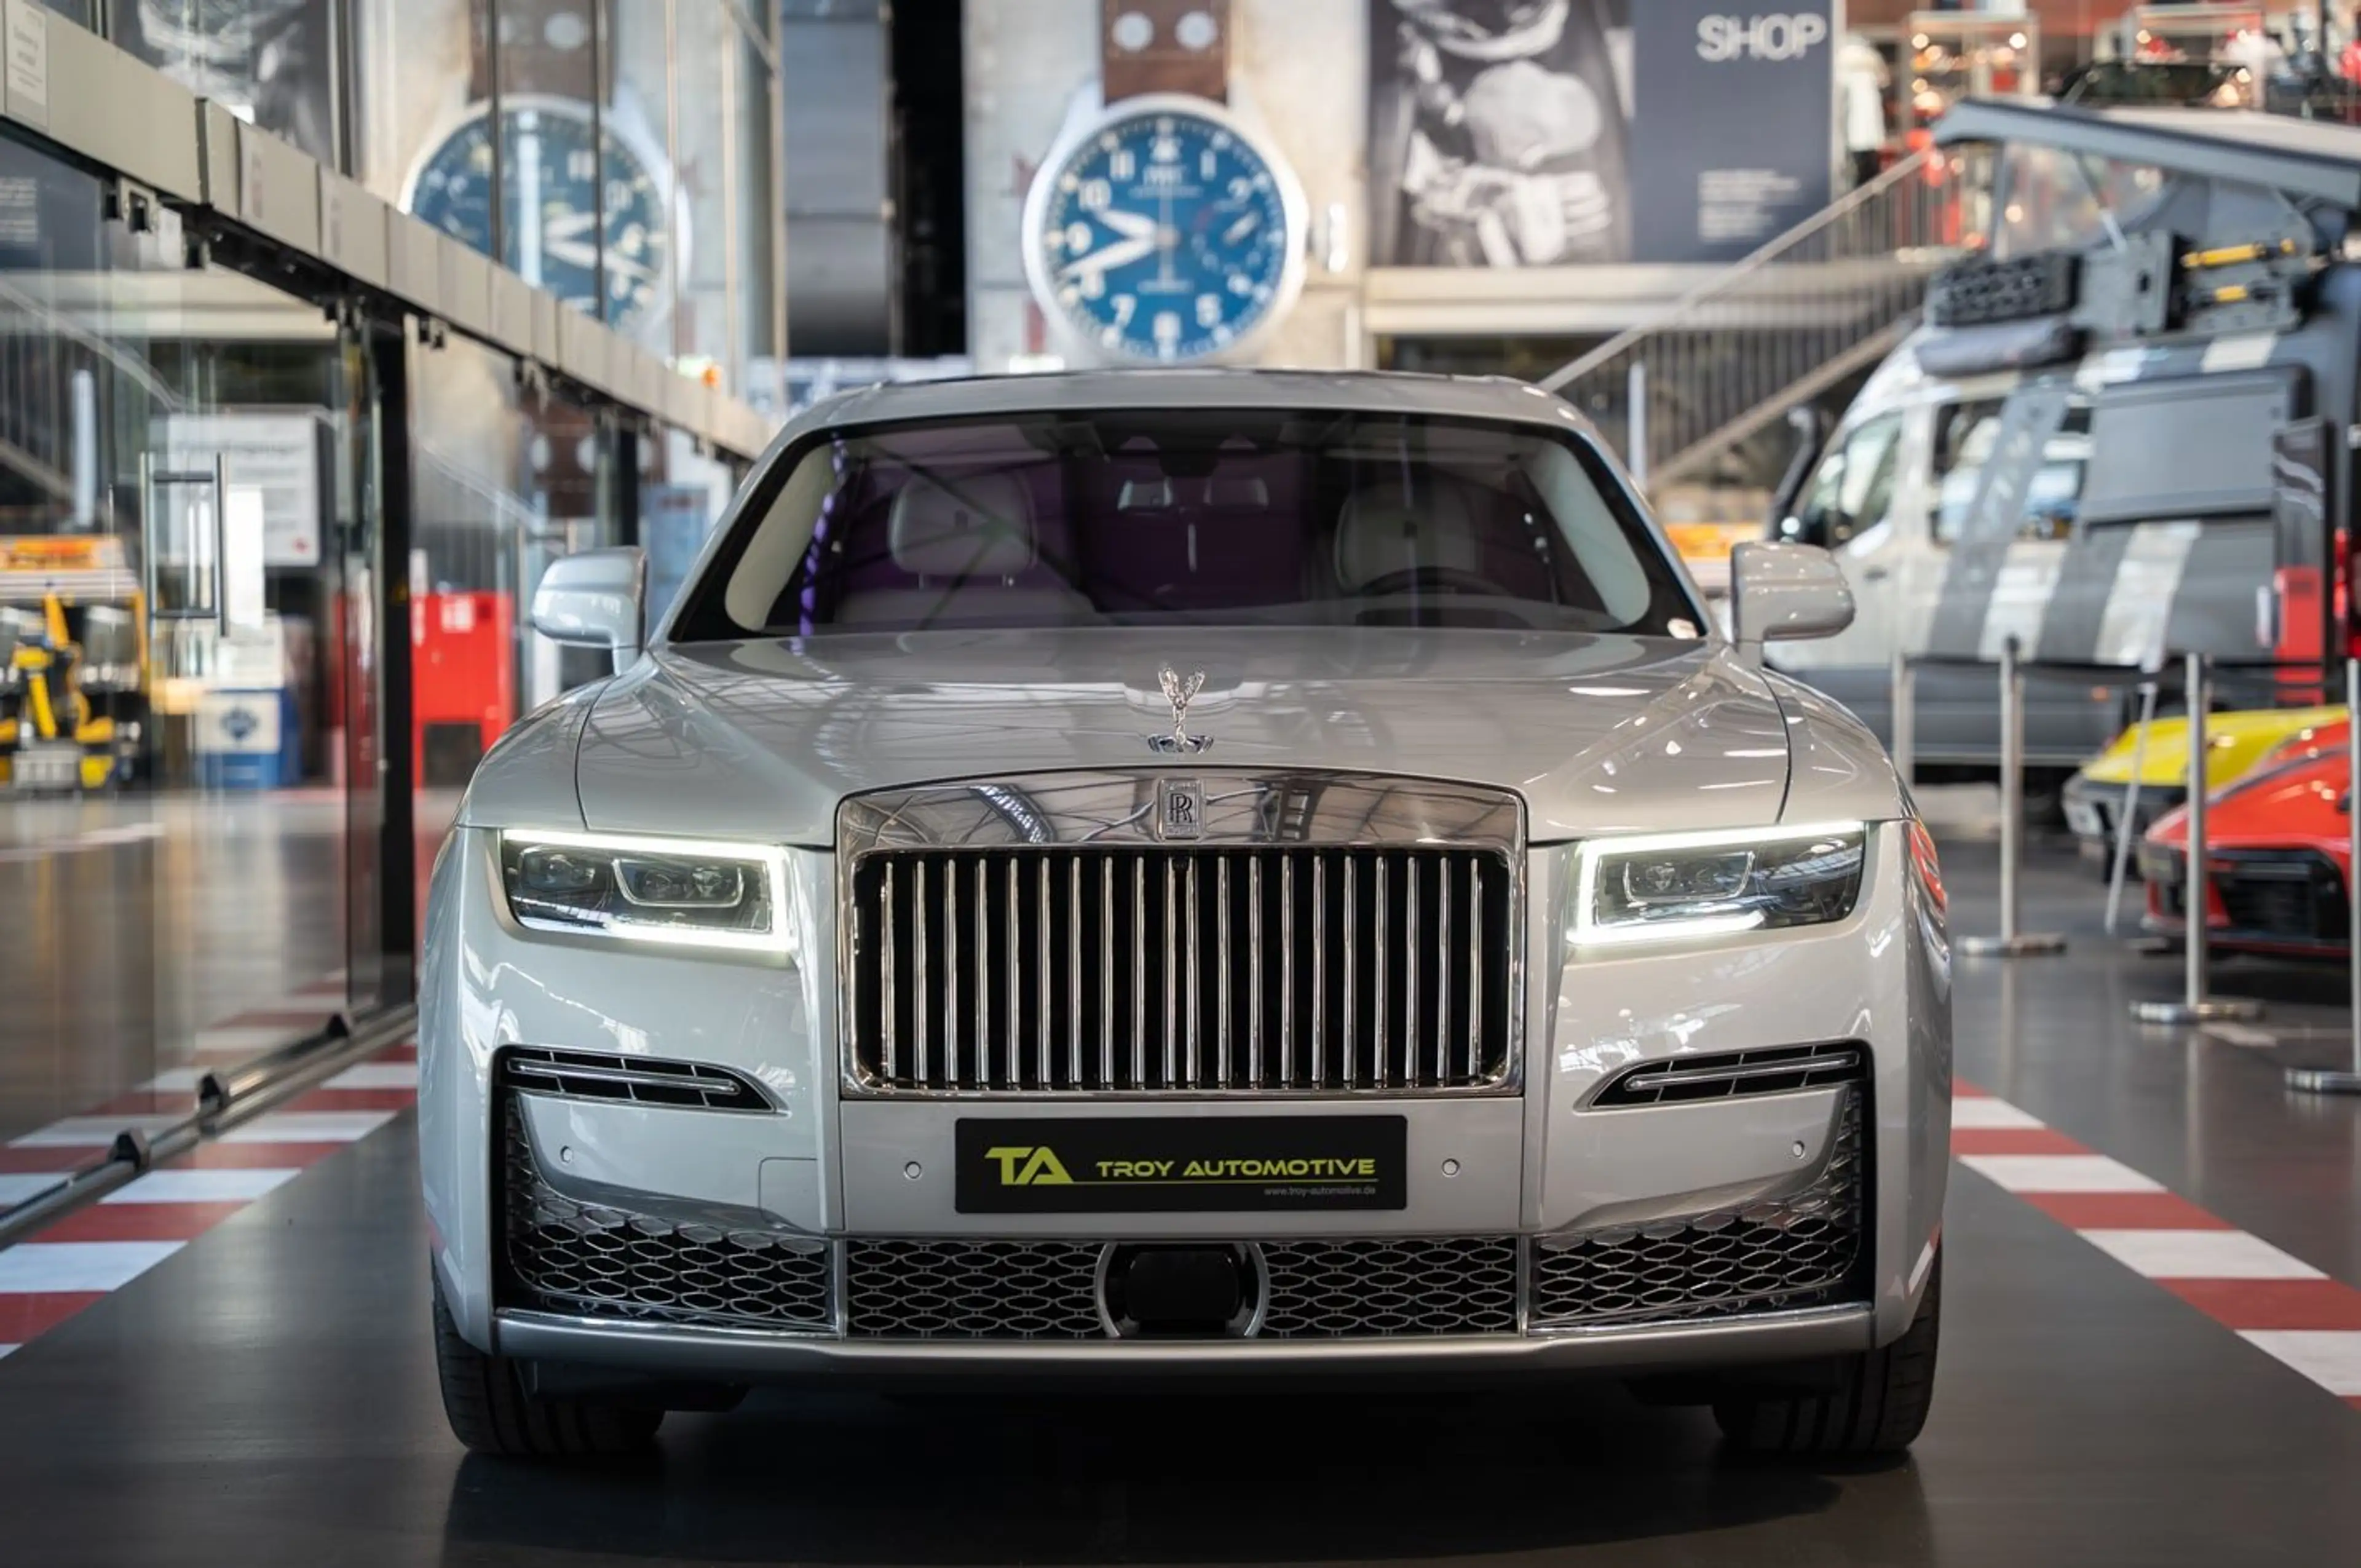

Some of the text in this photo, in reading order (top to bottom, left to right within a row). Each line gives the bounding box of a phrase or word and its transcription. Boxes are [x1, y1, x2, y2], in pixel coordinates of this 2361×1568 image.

[1695, 13, 1827, 61] SHOP
[1110, 293, 1137, 329] 7
[984, 1146, 1074, 1185] TA
[1096, 1158, 1376, 1177] TROY AUTOMOTIVE
[1264, 1186, 1376, 1198] www.troy-automotive.de
